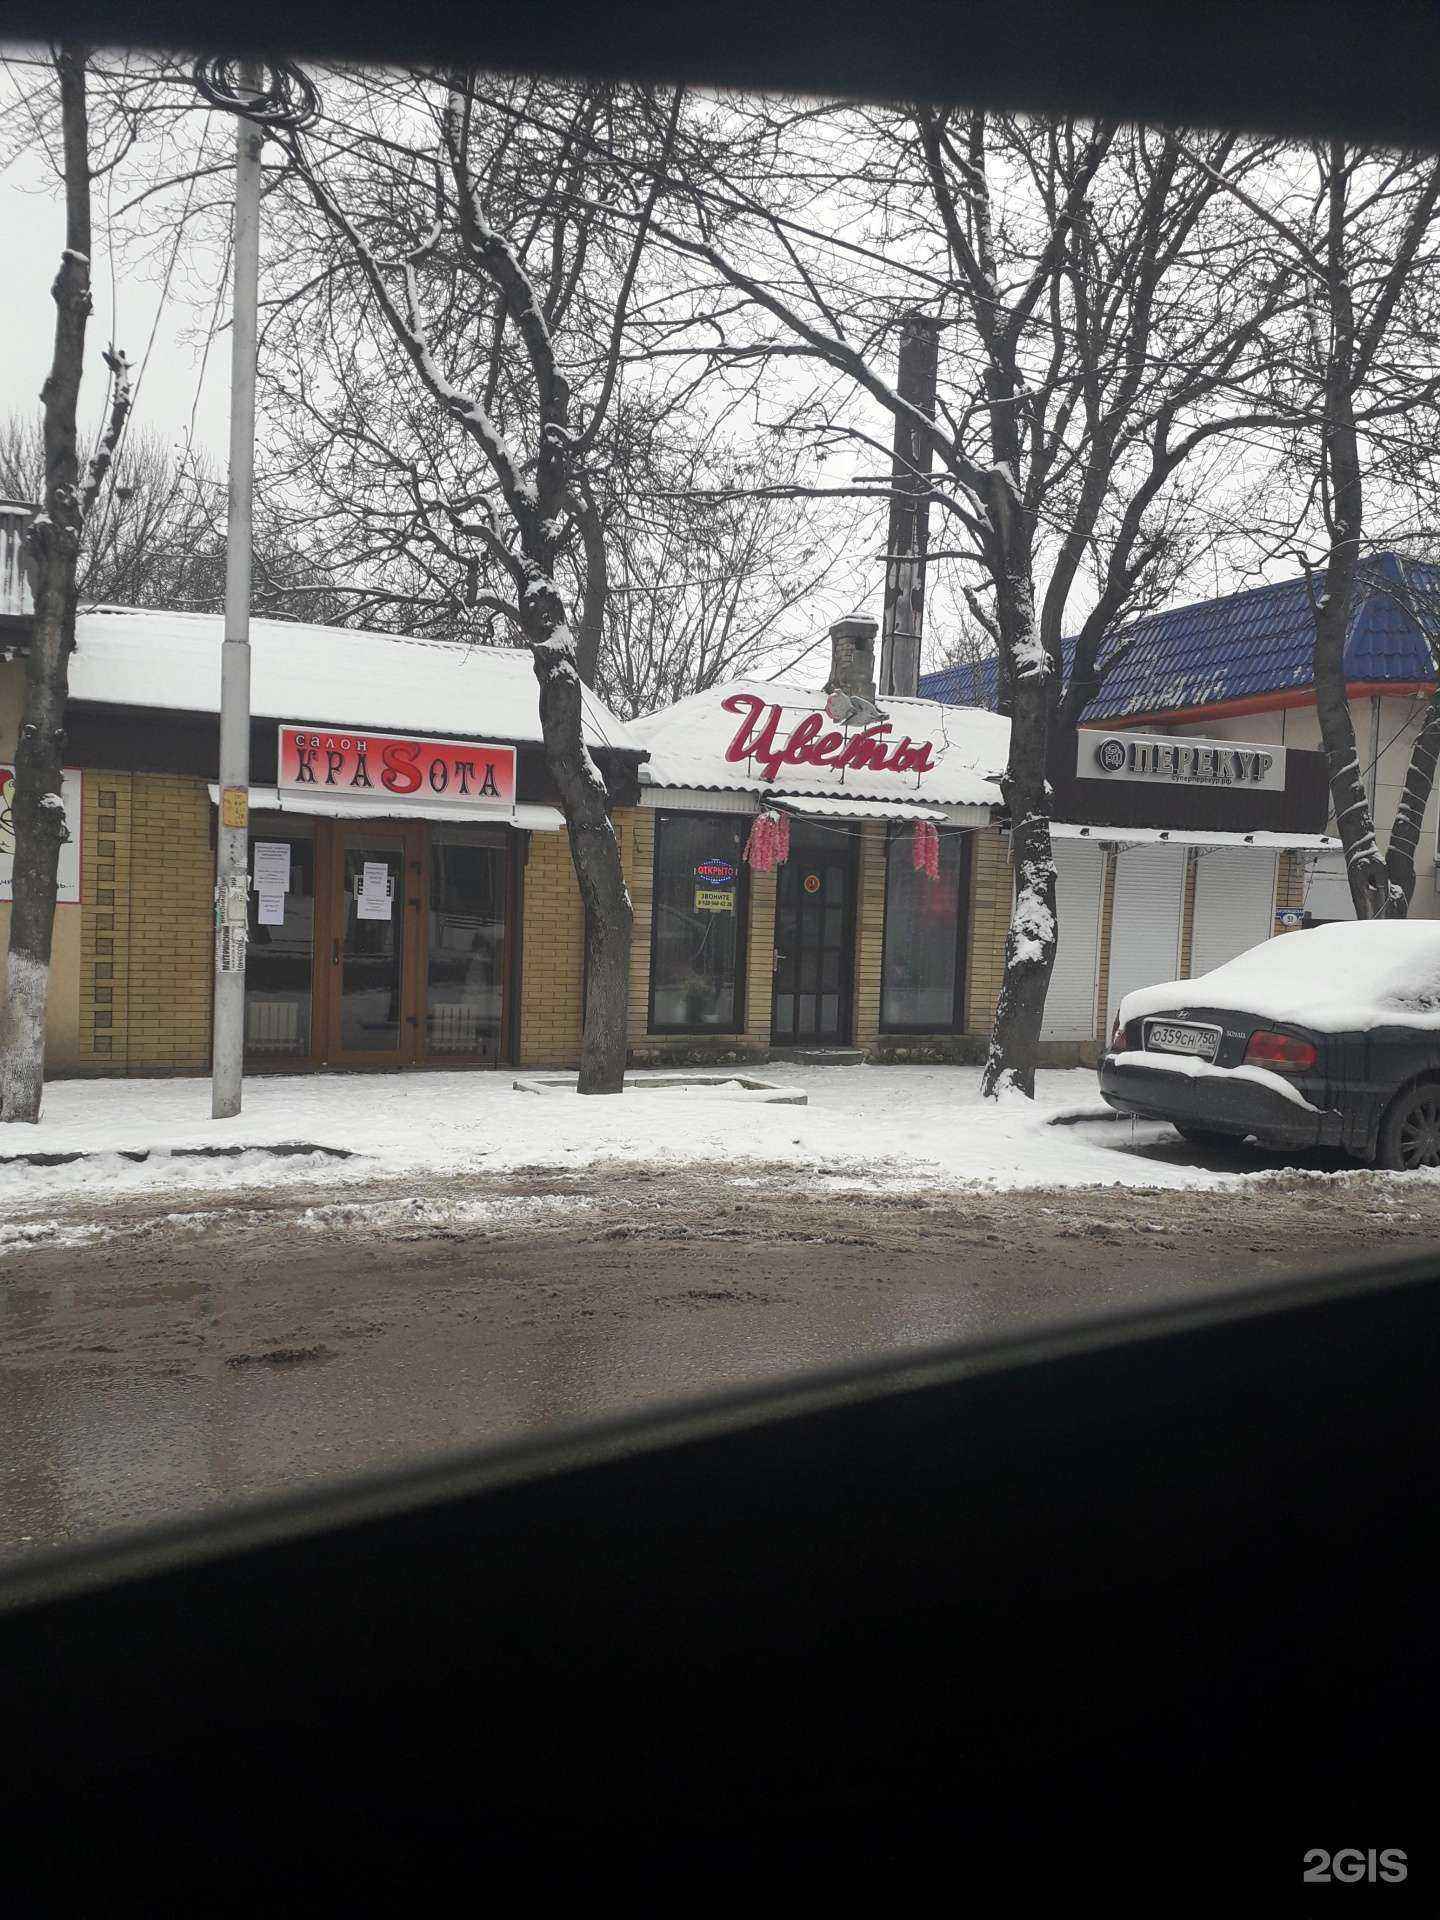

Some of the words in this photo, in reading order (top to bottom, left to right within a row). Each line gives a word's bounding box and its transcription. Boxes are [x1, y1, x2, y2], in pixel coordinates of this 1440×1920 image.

[721, 693, 935, 783] Цветы
[1130, 740, 1274, 782] ПЕРЕКУР
[697, 866, 734, 876] ОТКРЫТО
